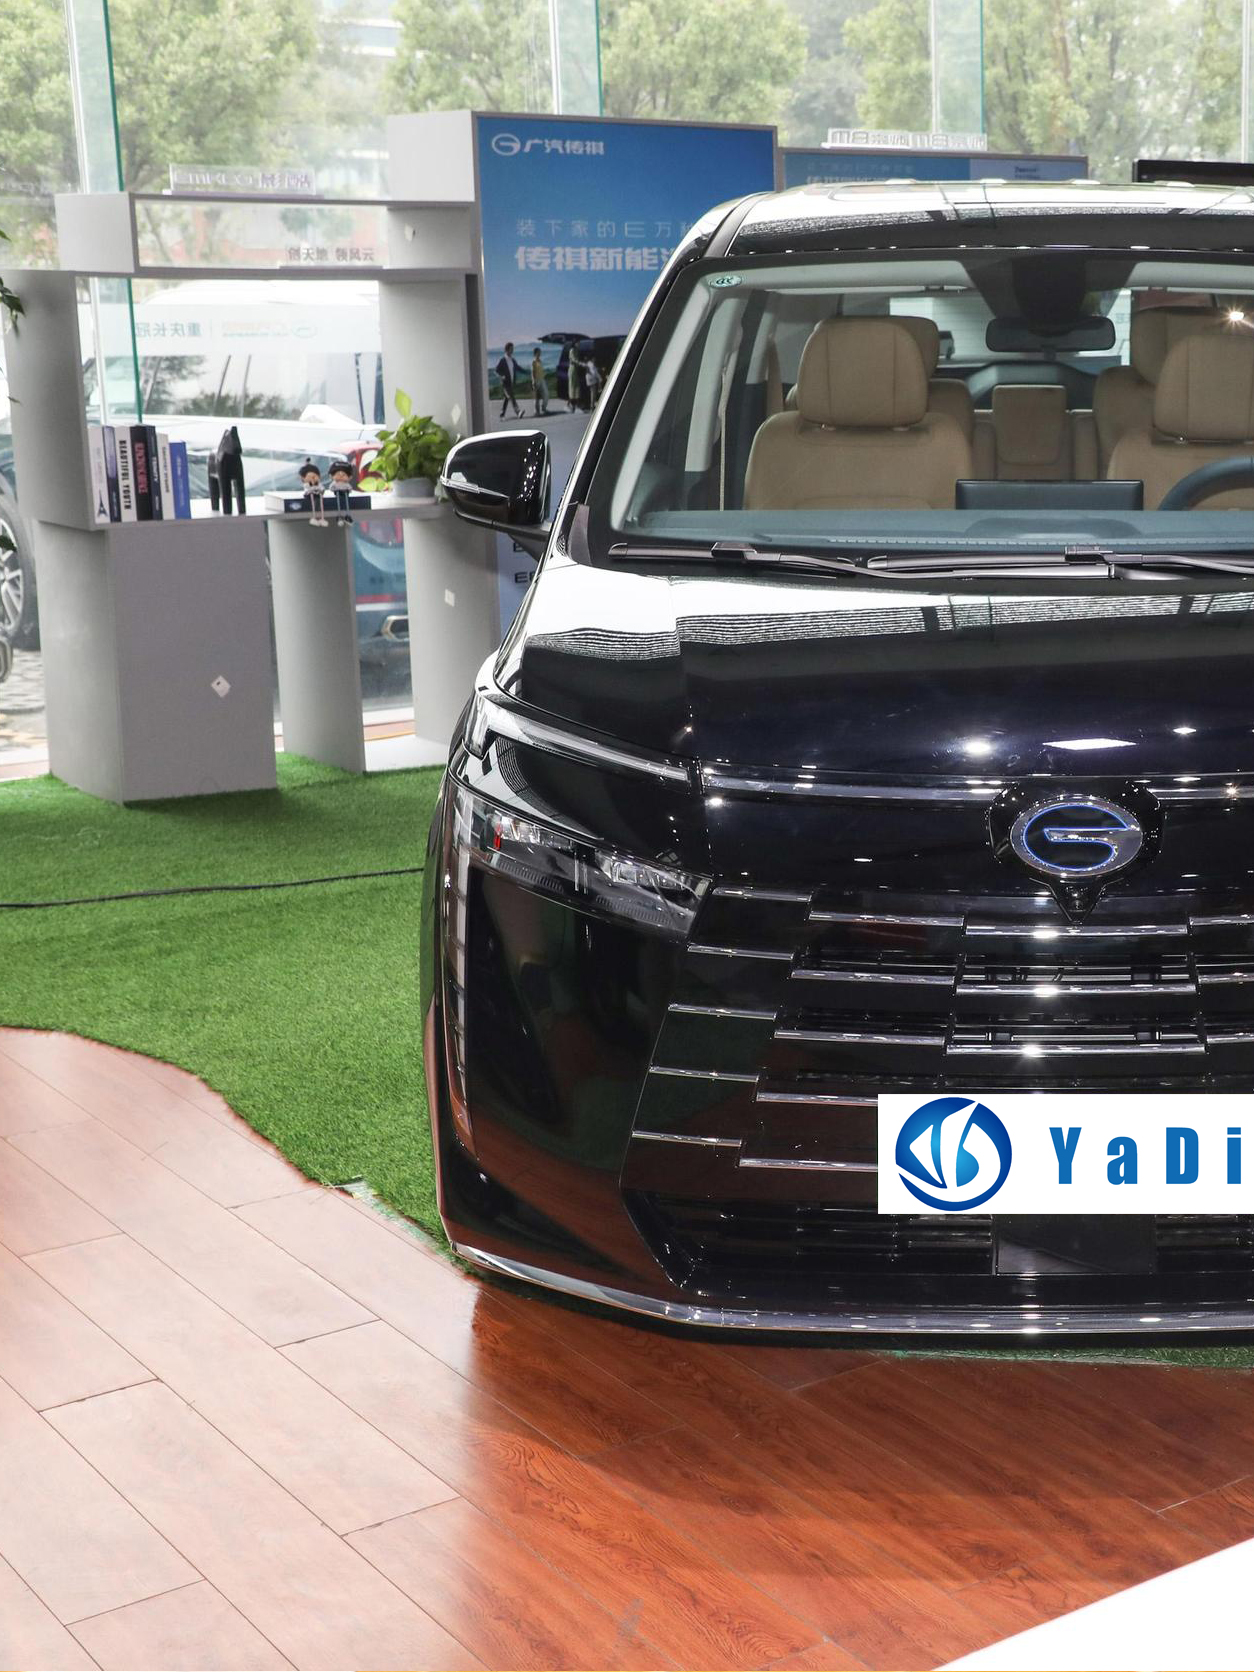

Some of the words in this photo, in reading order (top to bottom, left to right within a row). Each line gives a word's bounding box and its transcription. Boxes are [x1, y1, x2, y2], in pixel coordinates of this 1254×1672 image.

[524, 138, 605, 155] 广汽传祺
[514, 245, 674, 272] 传祺新能
[119, 440, 129, 481] BEAUTIFUL
[123, 484, 132, 510] YOUTH
